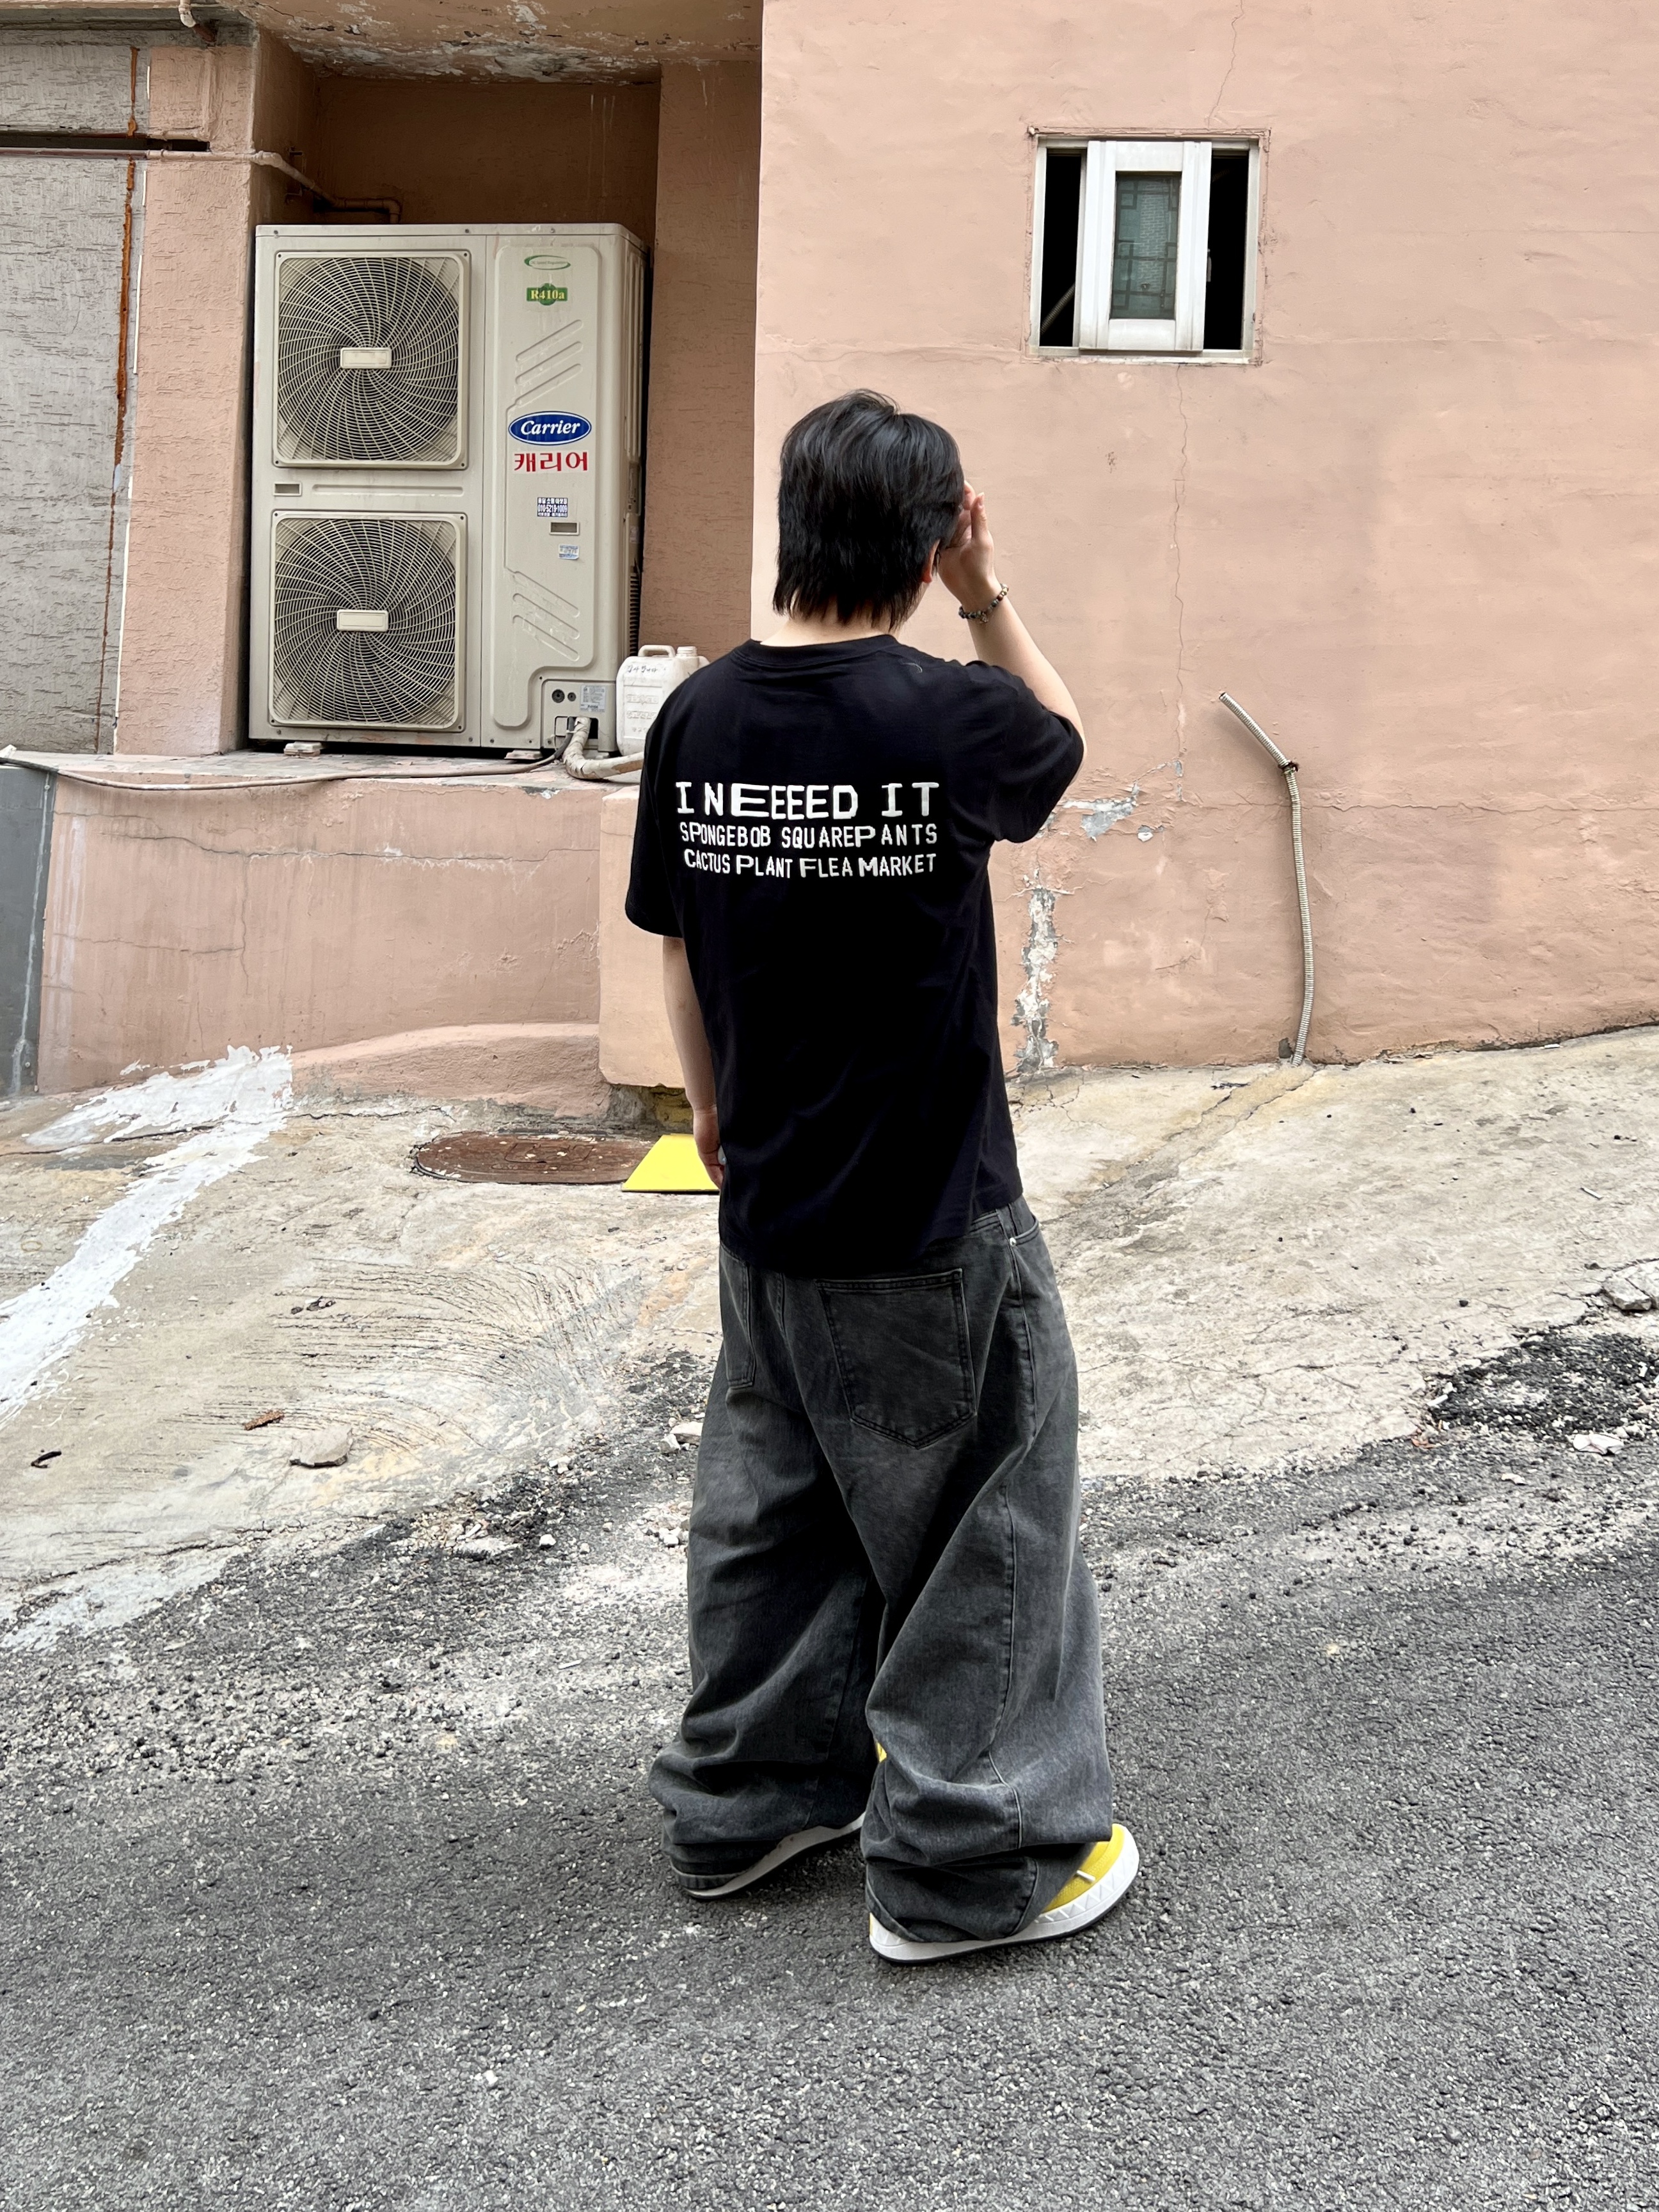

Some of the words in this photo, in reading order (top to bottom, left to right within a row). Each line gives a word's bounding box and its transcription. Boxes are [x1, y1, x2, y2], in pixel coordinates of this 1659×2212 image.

[530, 289, 565, 299] R410a
[520, 420, 580, 435] Carrier
[514, 451, 588, 472] 캐리어
[676, 782, 694, 813] I
[705, 783, 858, 820] NEEEED
[882, 783, 939, 816] IT
[680, 822, 770, 847] SPONGEBOB
[782, 824, 937, 849] SQUAREPANTS
[685, 849, 730, 873] CACTUS
[736, 855, 793, 878] PLANT
[800, 857, 852, 877] FLEA
[859, 854, 936, 877] MARKET
